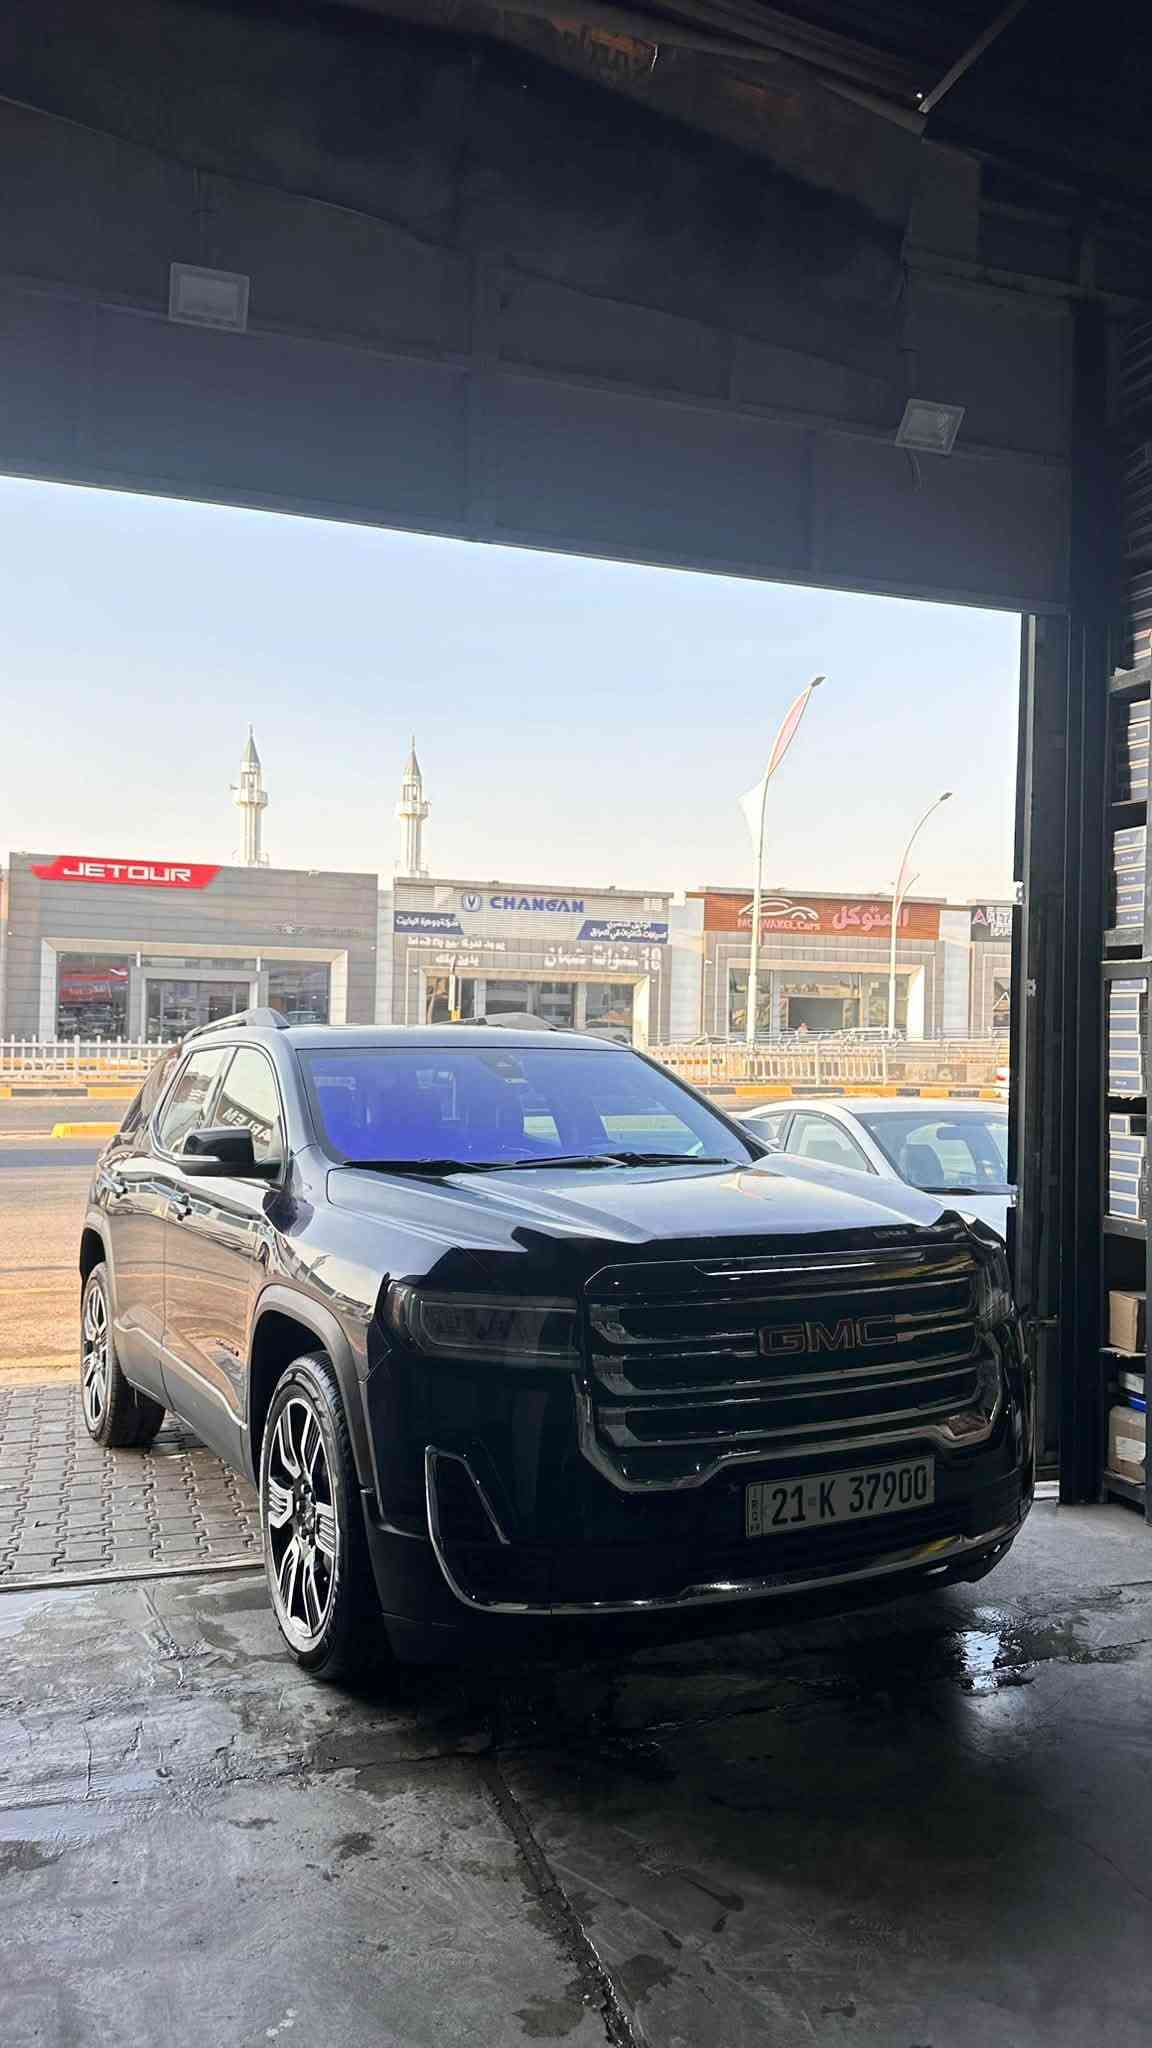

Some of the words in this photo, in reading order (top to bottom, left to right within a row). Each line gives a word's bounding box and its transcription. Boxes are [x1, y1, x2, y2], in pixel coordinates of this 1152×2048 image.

[63, 862, 192, 882] JETOUR
[489, 896, 585, 913] CHANGAN
[758, 1313, 896, 1357] GMC
[771, 1484, 806, 1526] 21
[818, 1479, 836, 1518] K
[848, 1464, 928, 1513] 37900
